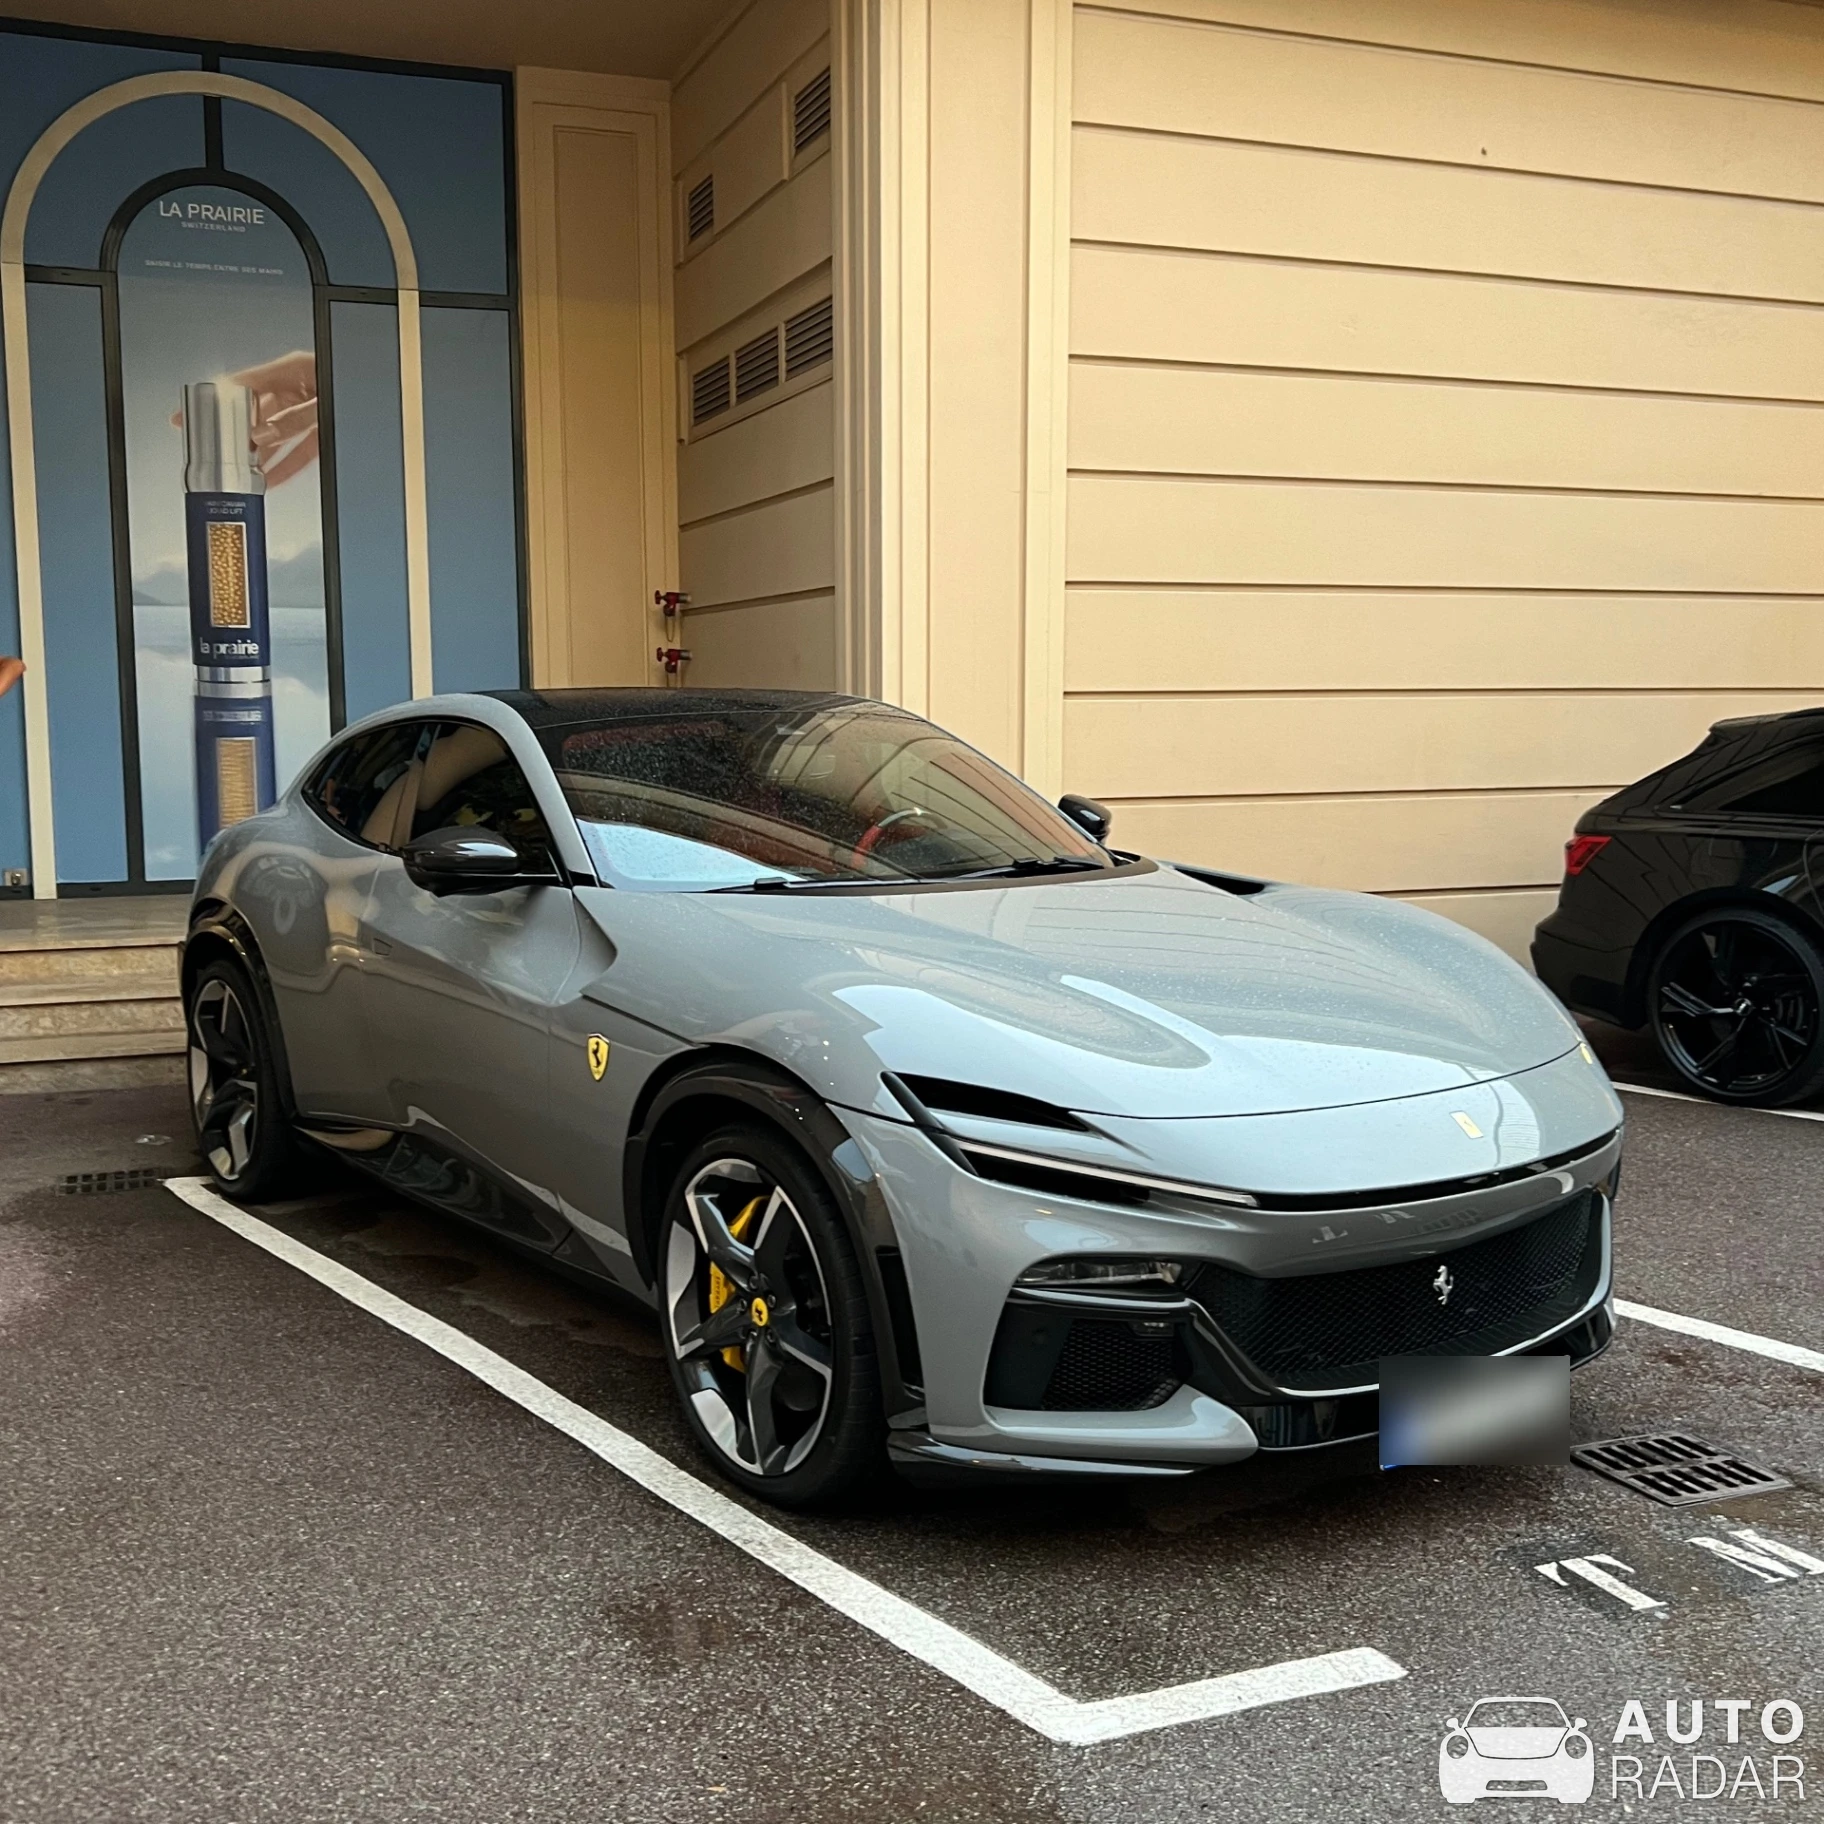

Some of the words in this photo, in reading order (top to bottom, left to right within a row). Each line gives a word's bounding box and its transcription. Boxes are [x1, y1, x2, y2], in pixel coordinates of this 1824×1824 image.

[159, 200, 182, 218] LA
[187, 203, 265, 225] PRAIRIE
[181, 221, 246, 233] SWITZERLAND
[199, 637, 211, 654] la
[213, 639, 260, 660] prairie
